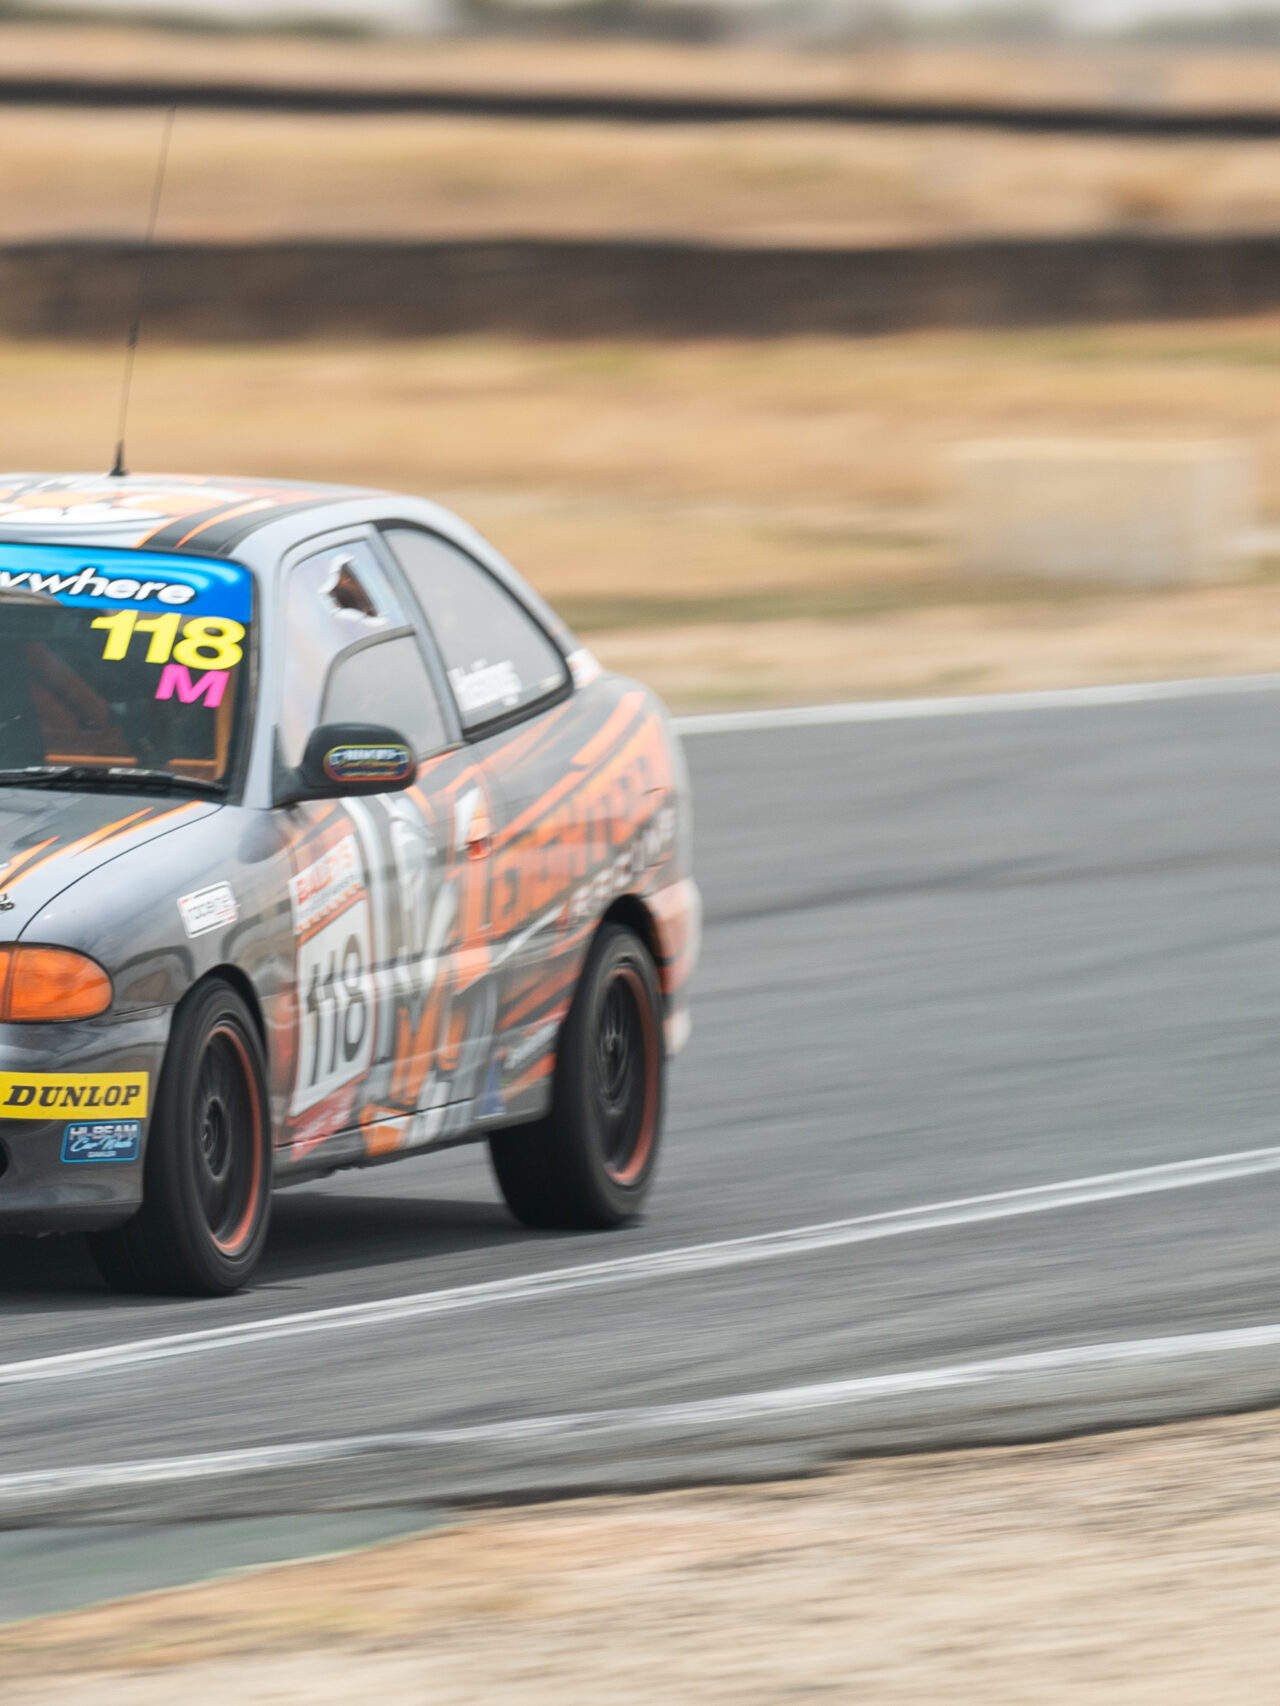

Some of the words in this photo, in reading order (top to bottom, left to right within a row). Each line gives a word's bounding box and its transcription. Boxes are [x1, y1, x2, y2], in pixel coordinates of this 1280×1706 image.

[90, 609, 246, 670] 118
[154, 663, 231, 709] M
[307, 932, 367, 1087] 118
[2, 1084, 141, 1108] DUNLOP
